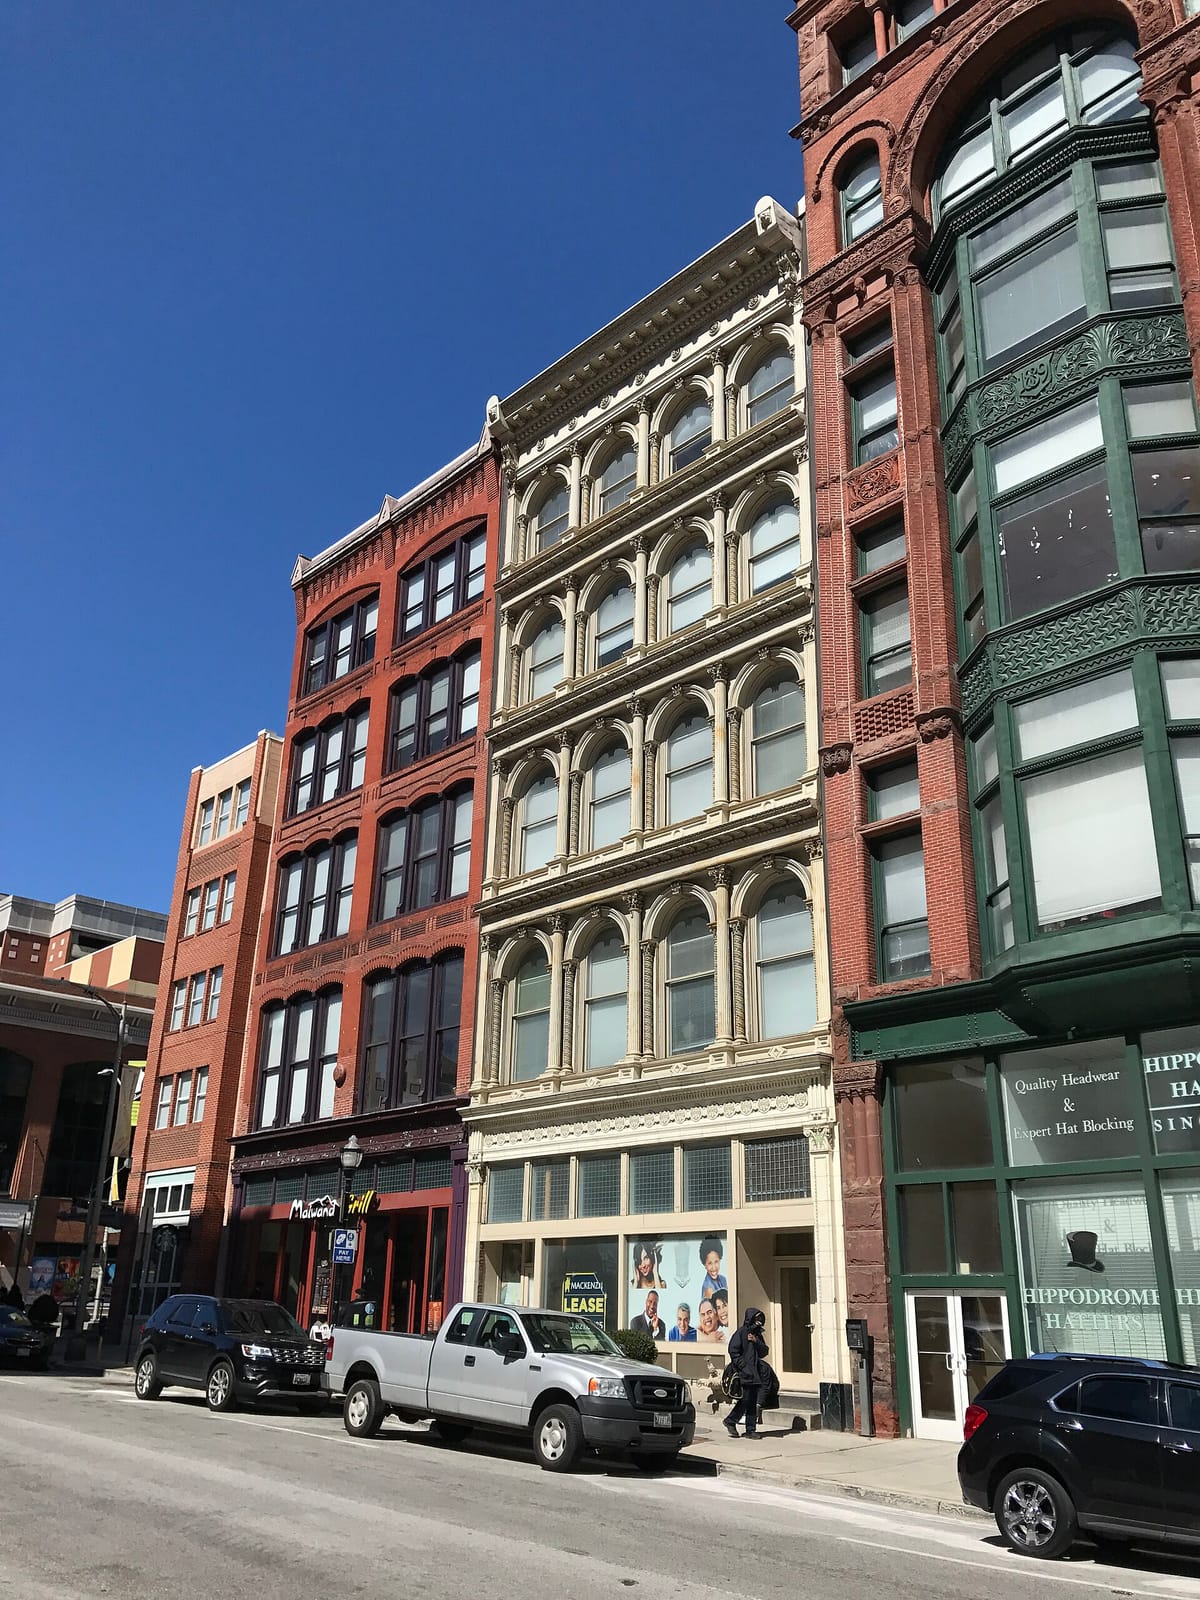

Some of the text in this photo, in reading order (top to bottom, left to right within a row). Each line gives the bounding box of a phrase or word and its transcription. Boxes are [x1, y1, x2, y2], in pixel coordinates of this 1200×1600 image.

[1143, 1052, 1200, 1074] HIPP
[1015, 1070, 1120, 1095] Quality Headwear
[1063, 1097, 1076, 1112] &
[1013, 1117, 1134, 1140] Expert Hat Blocking
[1153, 1116, 1200, 1132] SIN
[563, 1298, 604, 1313] LEASE
[1045, 1313, 1143, 1330] HATTERS
